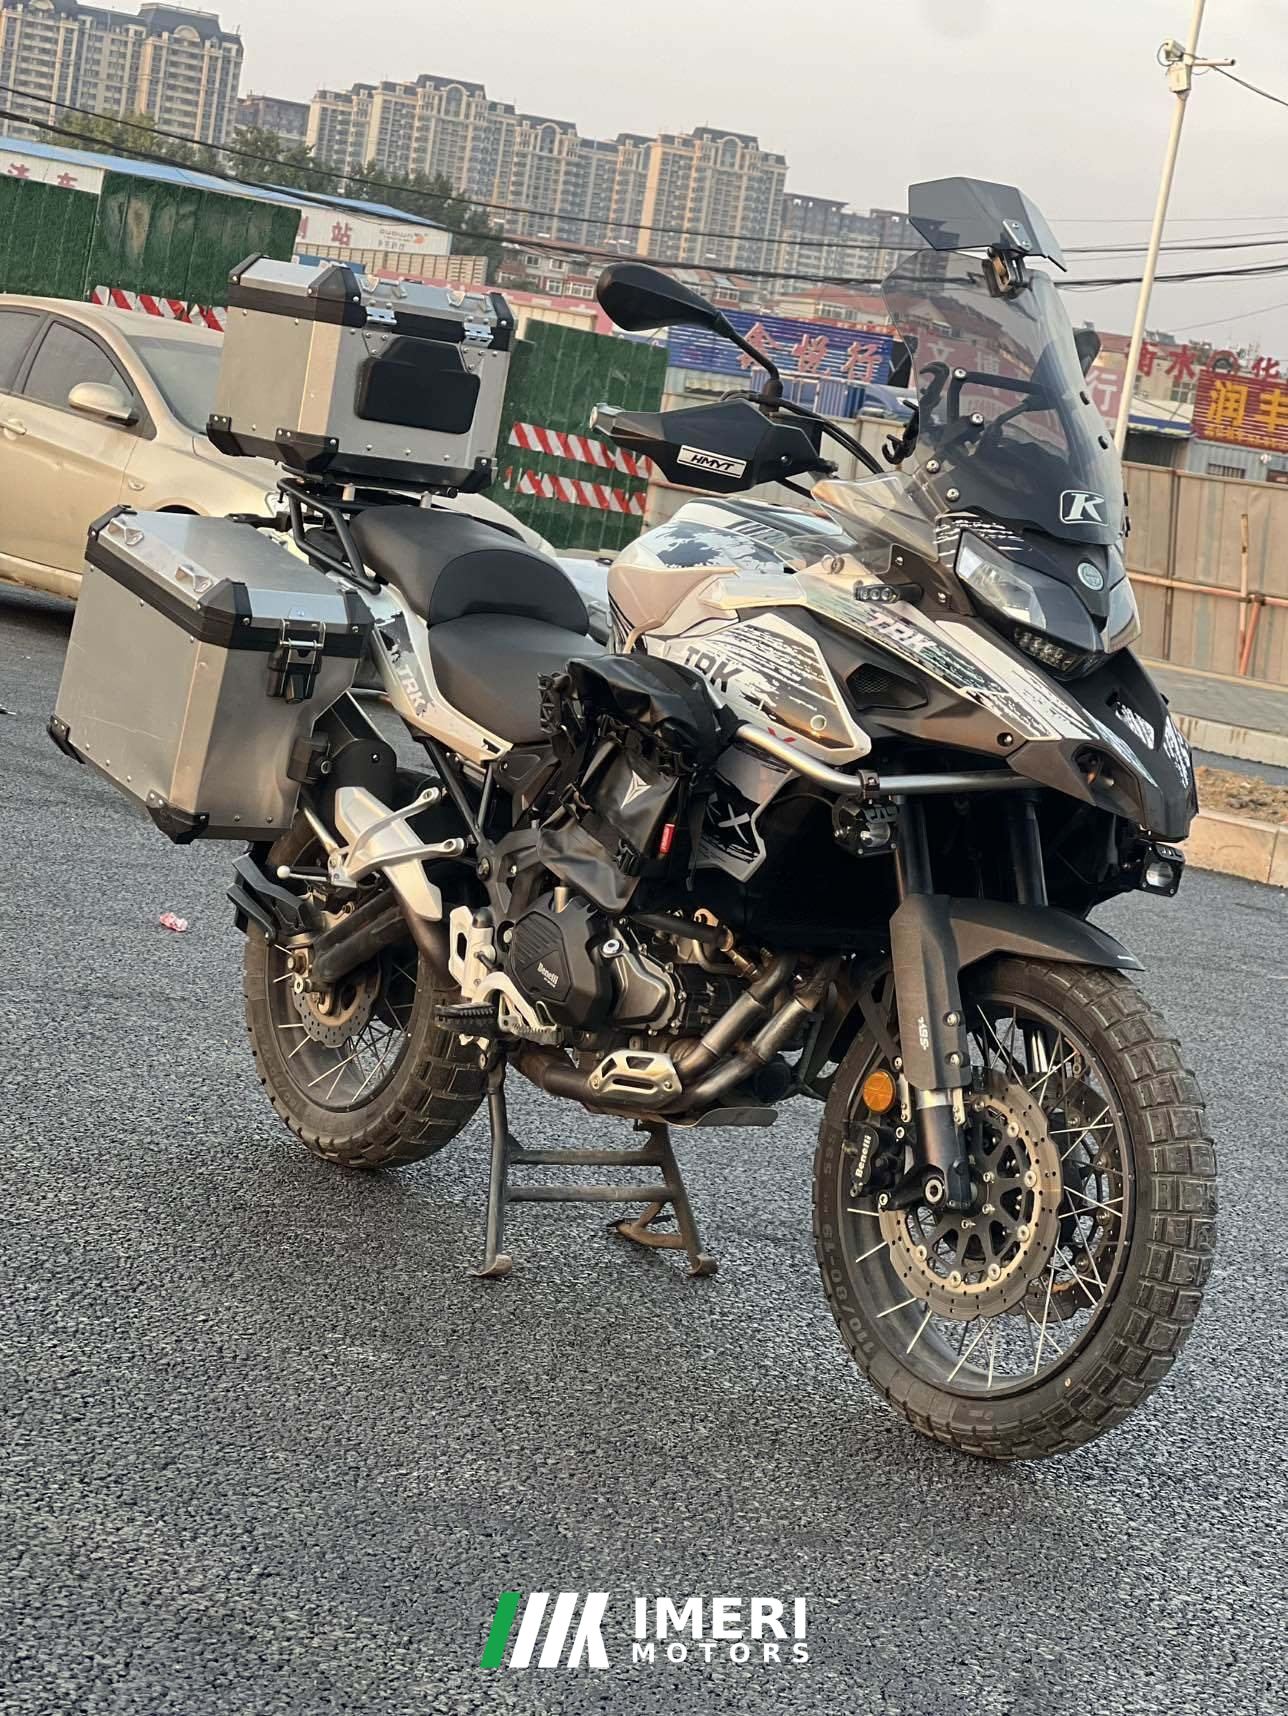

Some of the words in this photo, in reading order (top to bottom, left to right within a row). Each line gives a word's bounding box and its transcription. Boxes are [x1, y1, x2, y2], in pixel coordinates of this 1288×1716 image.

[690, 454, 735, 471] HMYT
[1065, 492, 1105, 522] K
[866, 612, 938, 653] TRK
[684, 645, 744, 693] TRK
[855, 1134, 871, 1178] Benelli
